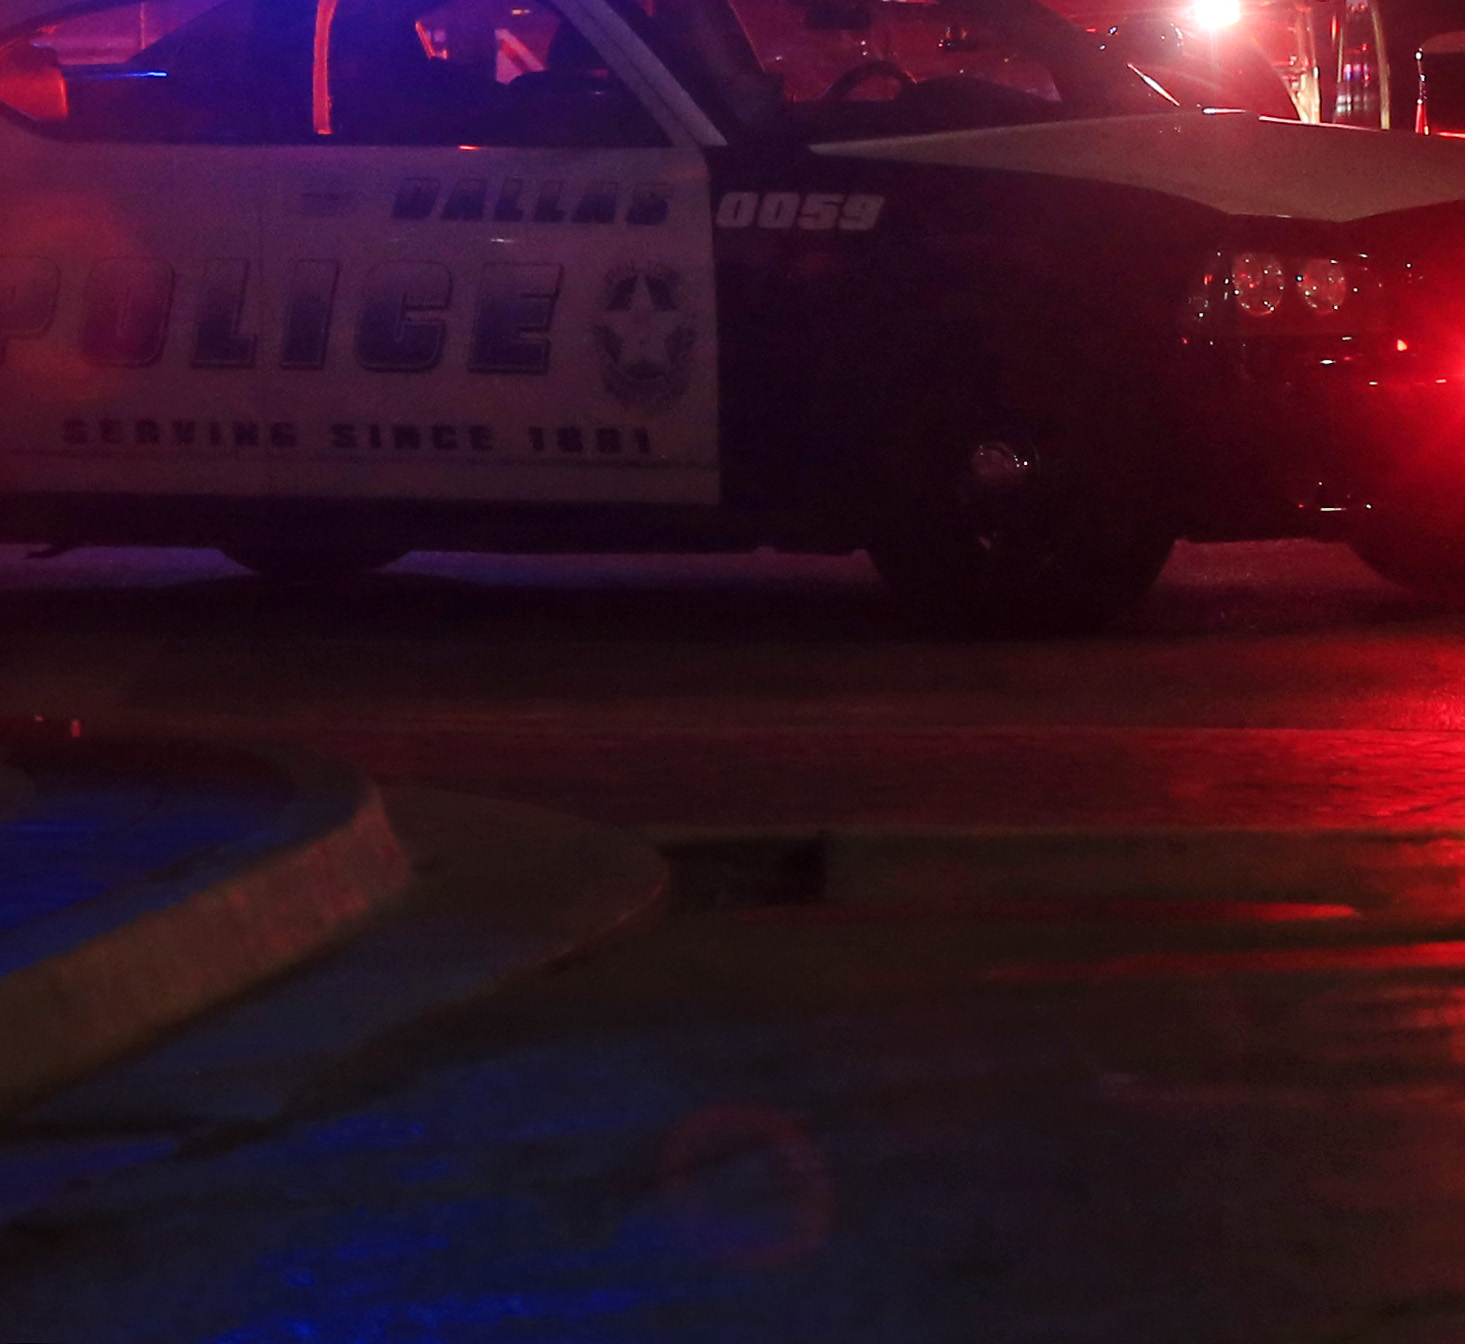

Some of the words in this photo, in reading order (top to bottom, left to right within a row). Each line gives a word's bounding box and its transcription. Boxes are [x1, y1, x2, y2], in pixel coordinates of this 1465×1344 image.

[392, 176, 671, 226] DALLAS
[715, 191, 886, 231] 0059
[62, 419, 298, 447] SERVING
[331, 423, 492, 451] SINCE
[528, 425, 650, 453] 1881
